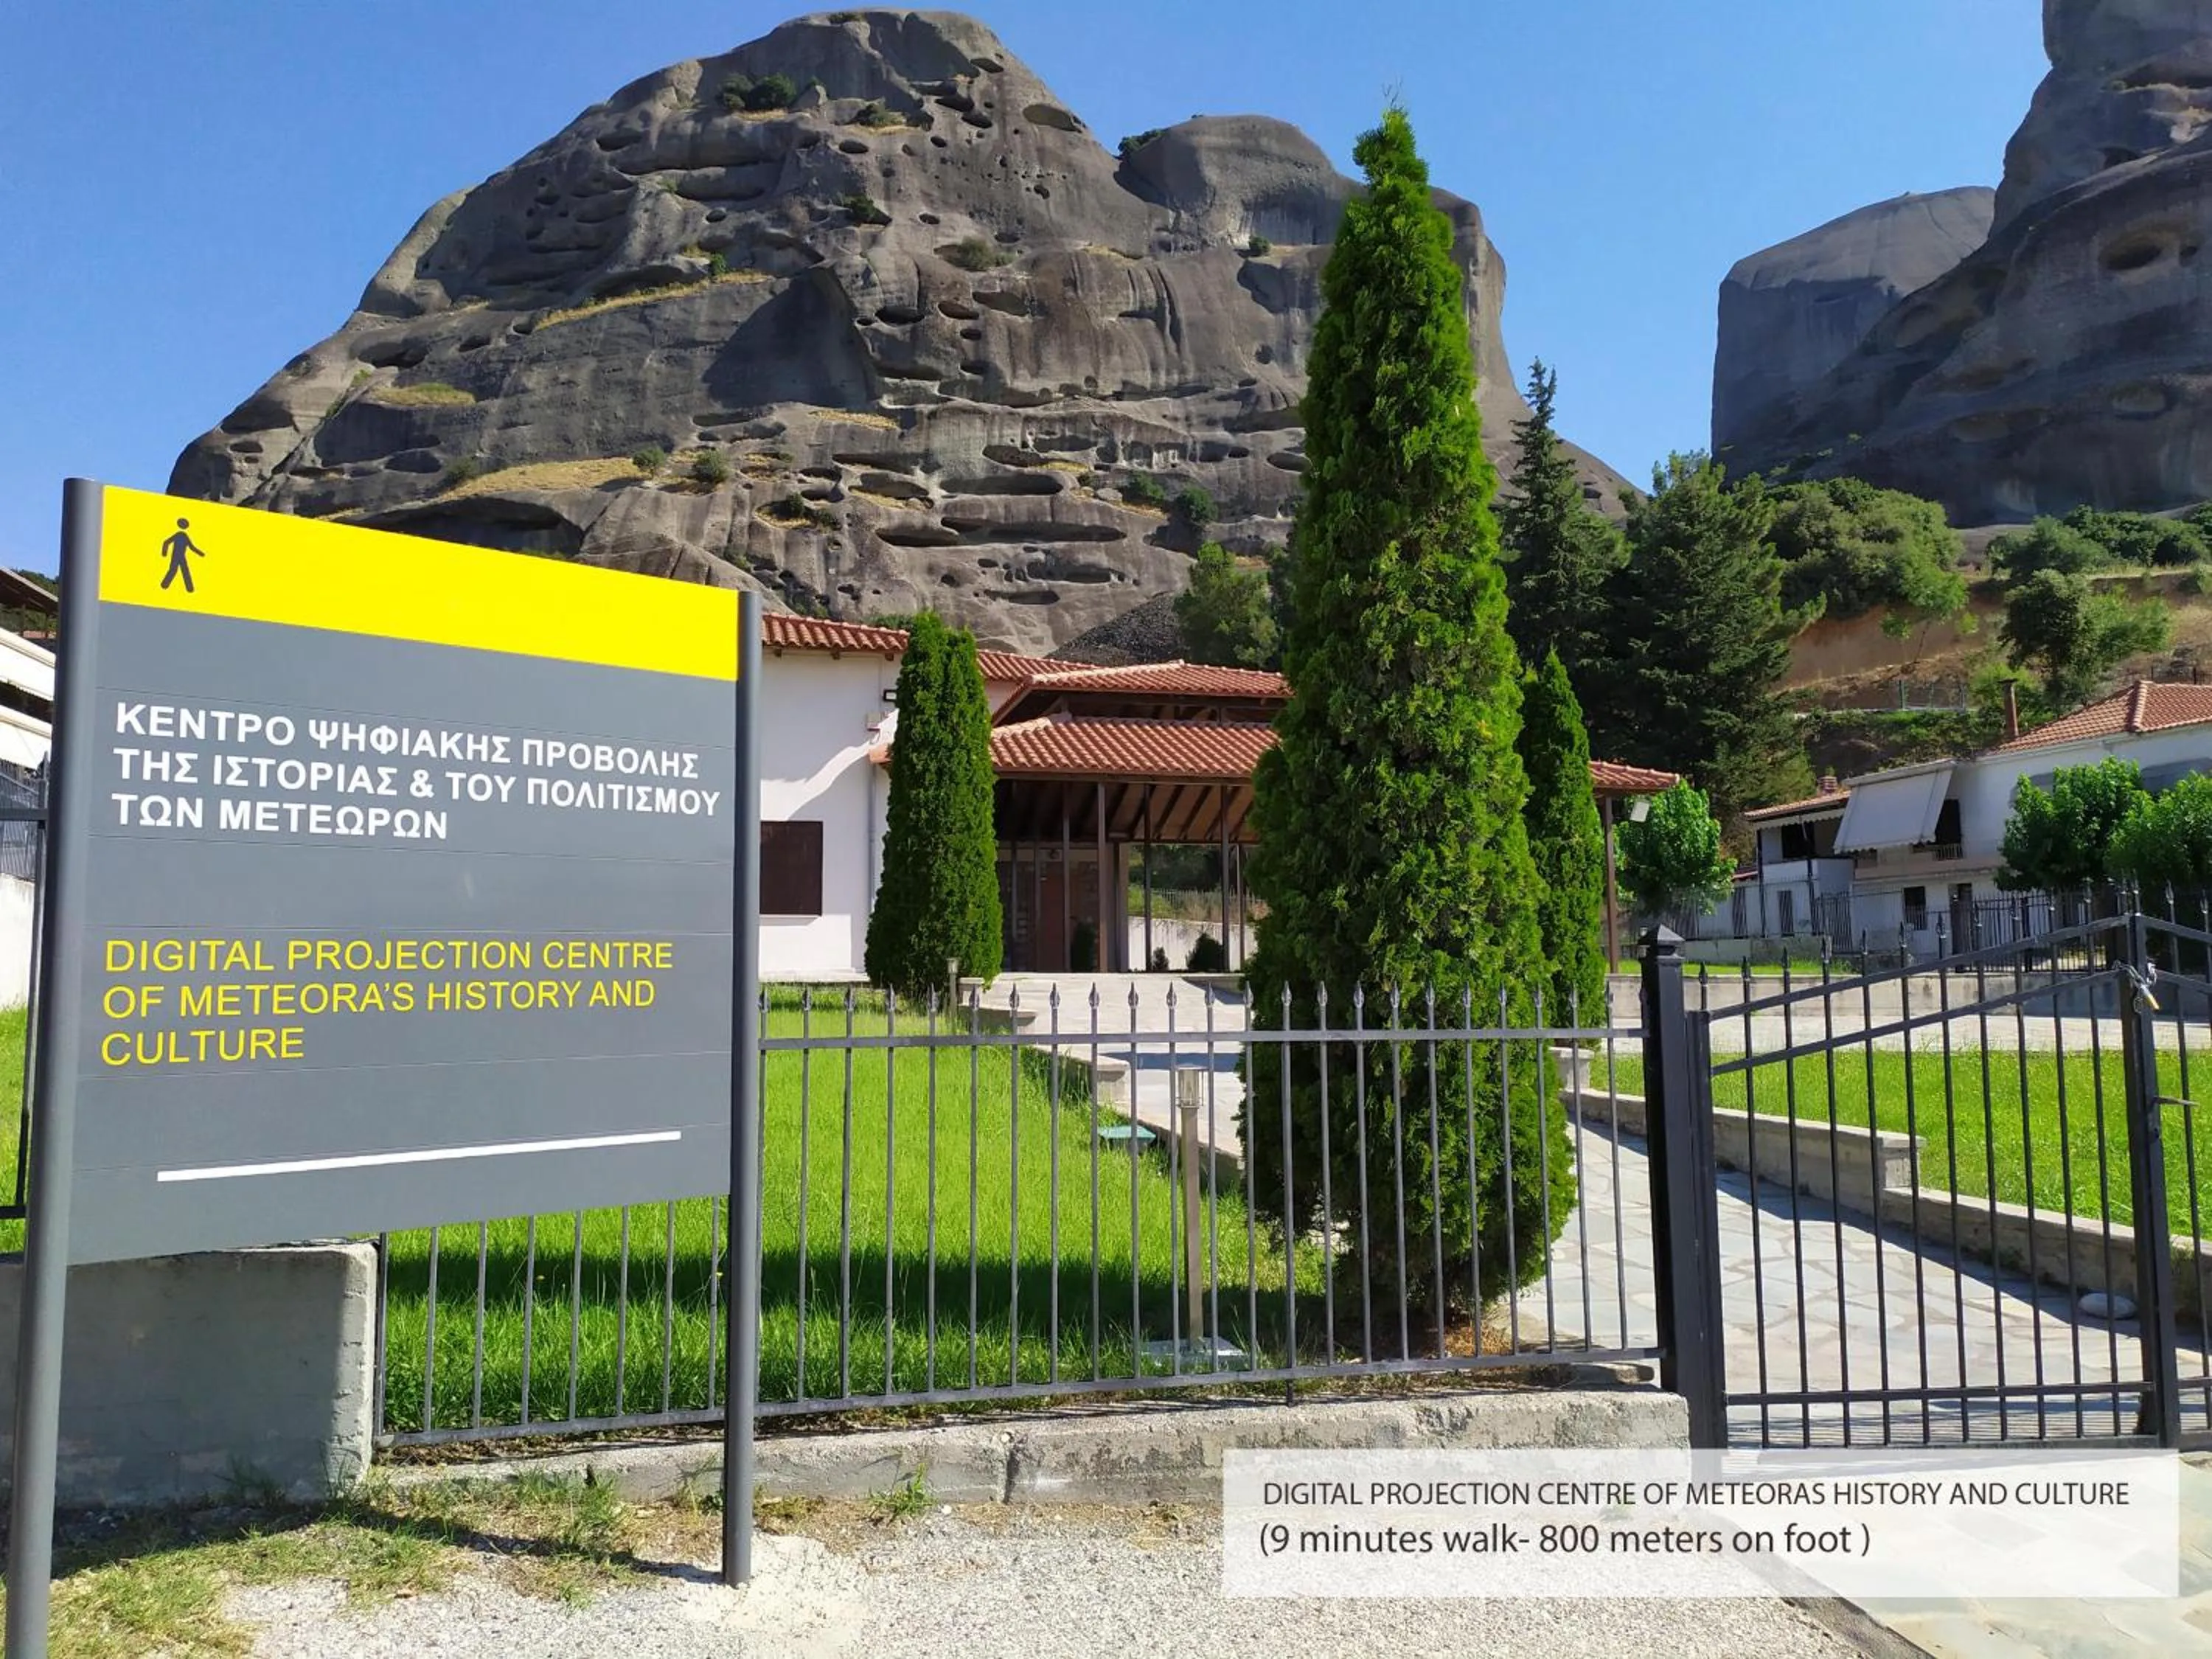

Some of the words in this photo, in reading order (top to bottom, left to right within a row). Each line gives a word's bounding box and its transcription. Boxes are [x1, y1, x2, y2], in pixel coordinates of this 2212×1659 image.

[116, 702, 295, 745] ΚΕΝΤΡΟ
[309, 720, 511, 763] ΨΗΦΙΑΚΗΣ
[523, 739, 698, 779] ΠΡΟΒΟΛΗΣ
[114, 748, 198, 783] ΤΗΣ
[214, 755, 397, 796] ΙΣΤΟΡΙΑΣ
[410, 769, 434, 798] &
[445, 771, 517, 802] ΤΟΥ
[527, 777, 720, 815] ΠΟΛΙΤΙΣΜΟΥ
[111, 793, 203, 828] ΤΩΝ
[220, 799, 447, 839] ΜΕΤΕΩΡΩΝ
[105, 939, 274, 973] DIGITAL
[288, 939, 532, 970] PROJECTION
[541, 940, 672, 970] CENTRE
[103, 984, 164, 1019] OF
[426, 980, 582, 1011] HISTORY
[589, 979, 655, 1008] AND
[101, 1026, 305, 1066] CULTURE
